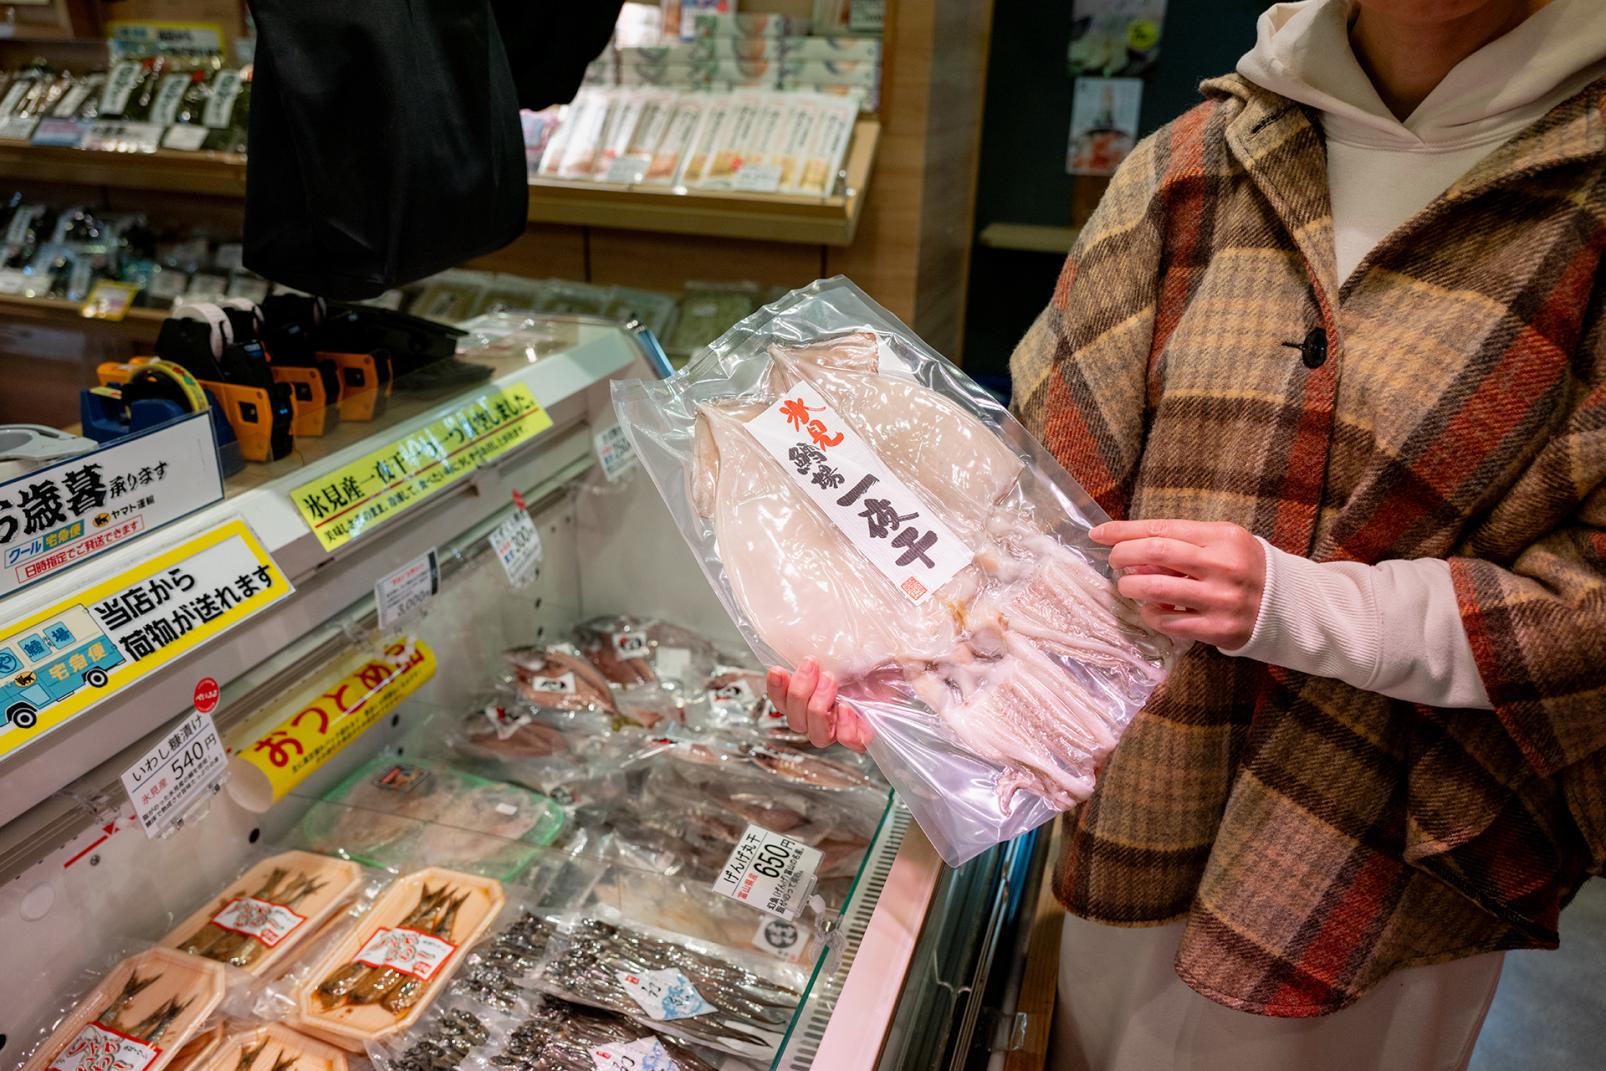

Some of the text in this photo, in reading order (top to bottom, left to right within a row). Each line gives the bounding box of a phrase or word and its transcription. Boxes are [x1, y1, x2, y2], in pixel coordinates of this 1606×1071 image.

[111, 494, 155, 519] ヤマト運輸
[779, 398, 844, 452] 氷見
[836, 473, 938, 568] 一夜干
[25, 521, 139, 577] 日時指定でご発送できます
[94, 568, 195, 631] 当店から
[119, 564, 273, 662] 荷物が送れます
[48, 642, 107, 681] 宅急便
[254, 644, 425, 767] おつとめ品
[132, 715, 202, 782] いわし糠漬け
[171, 733, 217, 781] 540円
[723, 833, 761, 884] げんげ丸干
[754, 839, 795, 879] 650円
